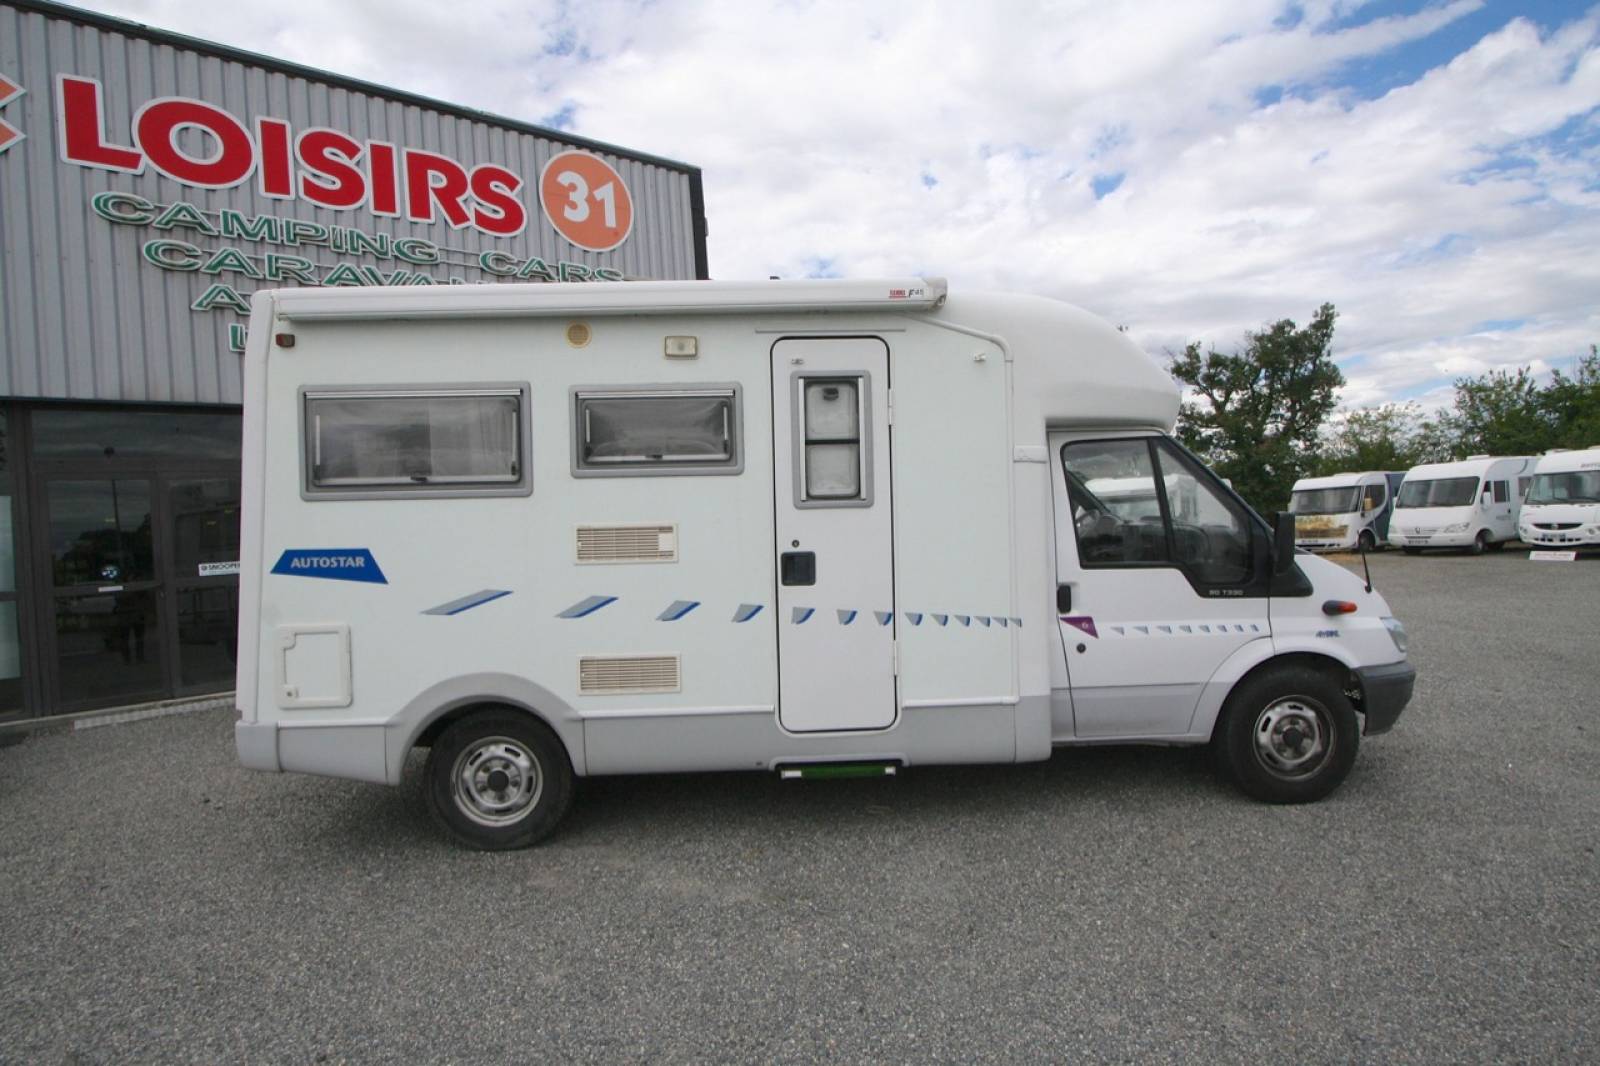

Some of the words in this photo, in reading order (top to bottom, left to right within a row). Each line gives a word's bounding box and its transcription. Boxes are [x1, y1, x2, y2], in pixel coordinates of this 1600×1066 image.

[58, 75, 525, 236] LOISIRS
[555, 171, 617, 228] 31
[92, 191, 441, 264] CAMPING
[479, 251, 625, 283] CARS
[291, 556, 365, 568] AUTOSTAR
